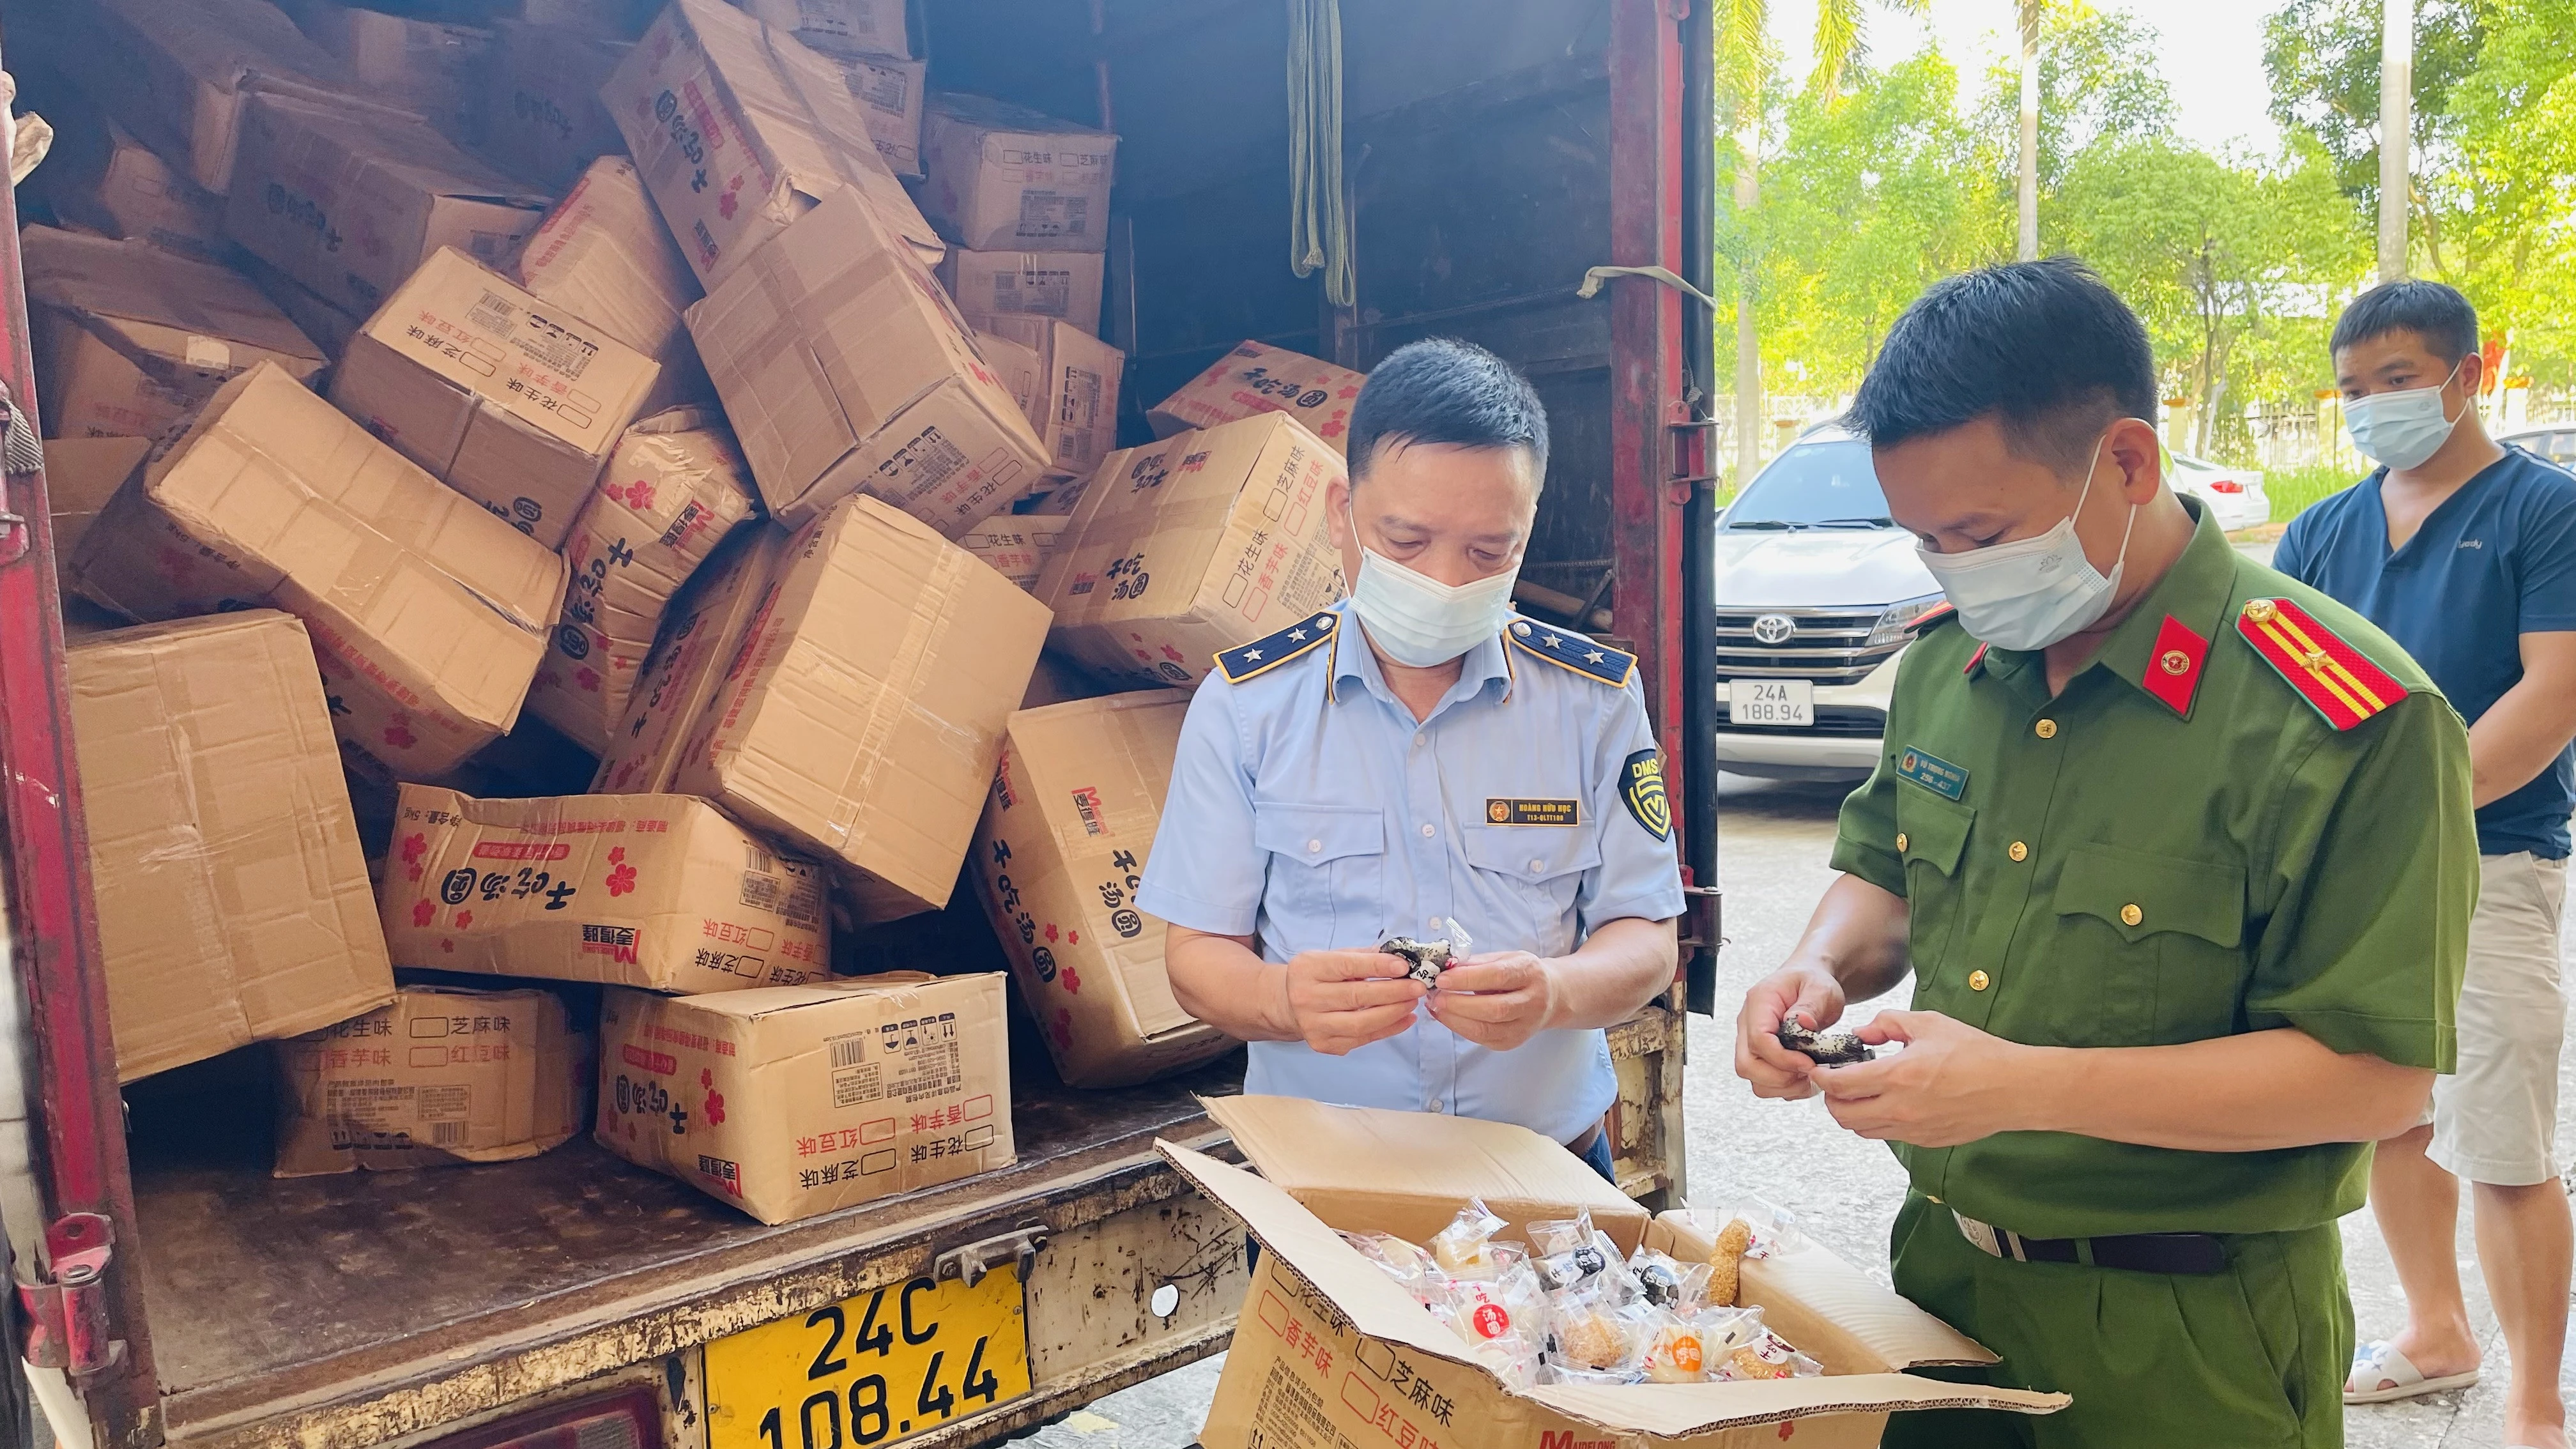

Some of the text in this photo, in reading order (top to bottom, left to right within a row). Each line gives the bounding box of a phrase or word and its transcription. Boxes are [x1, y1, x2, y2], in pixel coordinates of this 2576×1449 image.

[406, 325, 461, 358] 芝麻味
[419, 310, 473, 343] 红豆味
[507, 378, 557, 411] 花生味
[1244, 368, 1328, 408] 干吃汤圆
[1276, 445, 1305, 493] 芝麻味
[1296, 459, 1324, 507] 红豆味
[940, 468, 982, 505] 香芋味
[954, 481, 997, 516] 花生味
[988, 533, 1025, 547] 花生味
[1238, 530, 1269, 579] 花生味
[1107, 552, 1146, 580] 干吃
[1258, 543, 1288, 591] 香芋味
[559, 538, 633, 659] 干吃汤圆
[1112, 572, 1149, 601] 汤圆
[1754, 684, 1788, 702] 24A
[1742, 703, 1802, 721] 188.94
[1631, 758, 1659, 779] DMS
[1073, 793, 1100, 837] 麦得隆
[1519, 803, 1541, 812] HOÀNG
[441, 866, 576, 910] 干吃汤圆
[993, 839, 1056, 983] 干吃汤圆
[1099, 882, 1142, 938] 汤圆
[583, 924, 636, 946] 麦得隆
[703, 917, 748, 946] 红豆味
[695, 949, 739, 973] 芝麻味
[780, 939, 817, 963] 香芋味
[769, 964, 809, 985] 花生味
[333, 1015, 510, 1038] 花生味 芝麻味
[332, 1044, 510, 1068] 香芋味 红豆味
[615, 1073, 688, 1136] 干吃汤圆
[911, 1104, 962, 1132] 香芋味
[797, 1128, 858, 1158] 红豆味
[911, 1135, 963, 1164] 花生味
[698, 1154, 737, 1180] 麦得隆
[799, 1159, 858, 1190] 芝麻味
[805, 1277, 939, 1381] 24C
[1286, 1317, 1333, 1379] 香芋味
[759, 1335, 998, 1449] 108.44
[1390, 1360, 1457, 1428] 芝麻味
[1538, 1430, 1616, 1449] MAIDELONG
